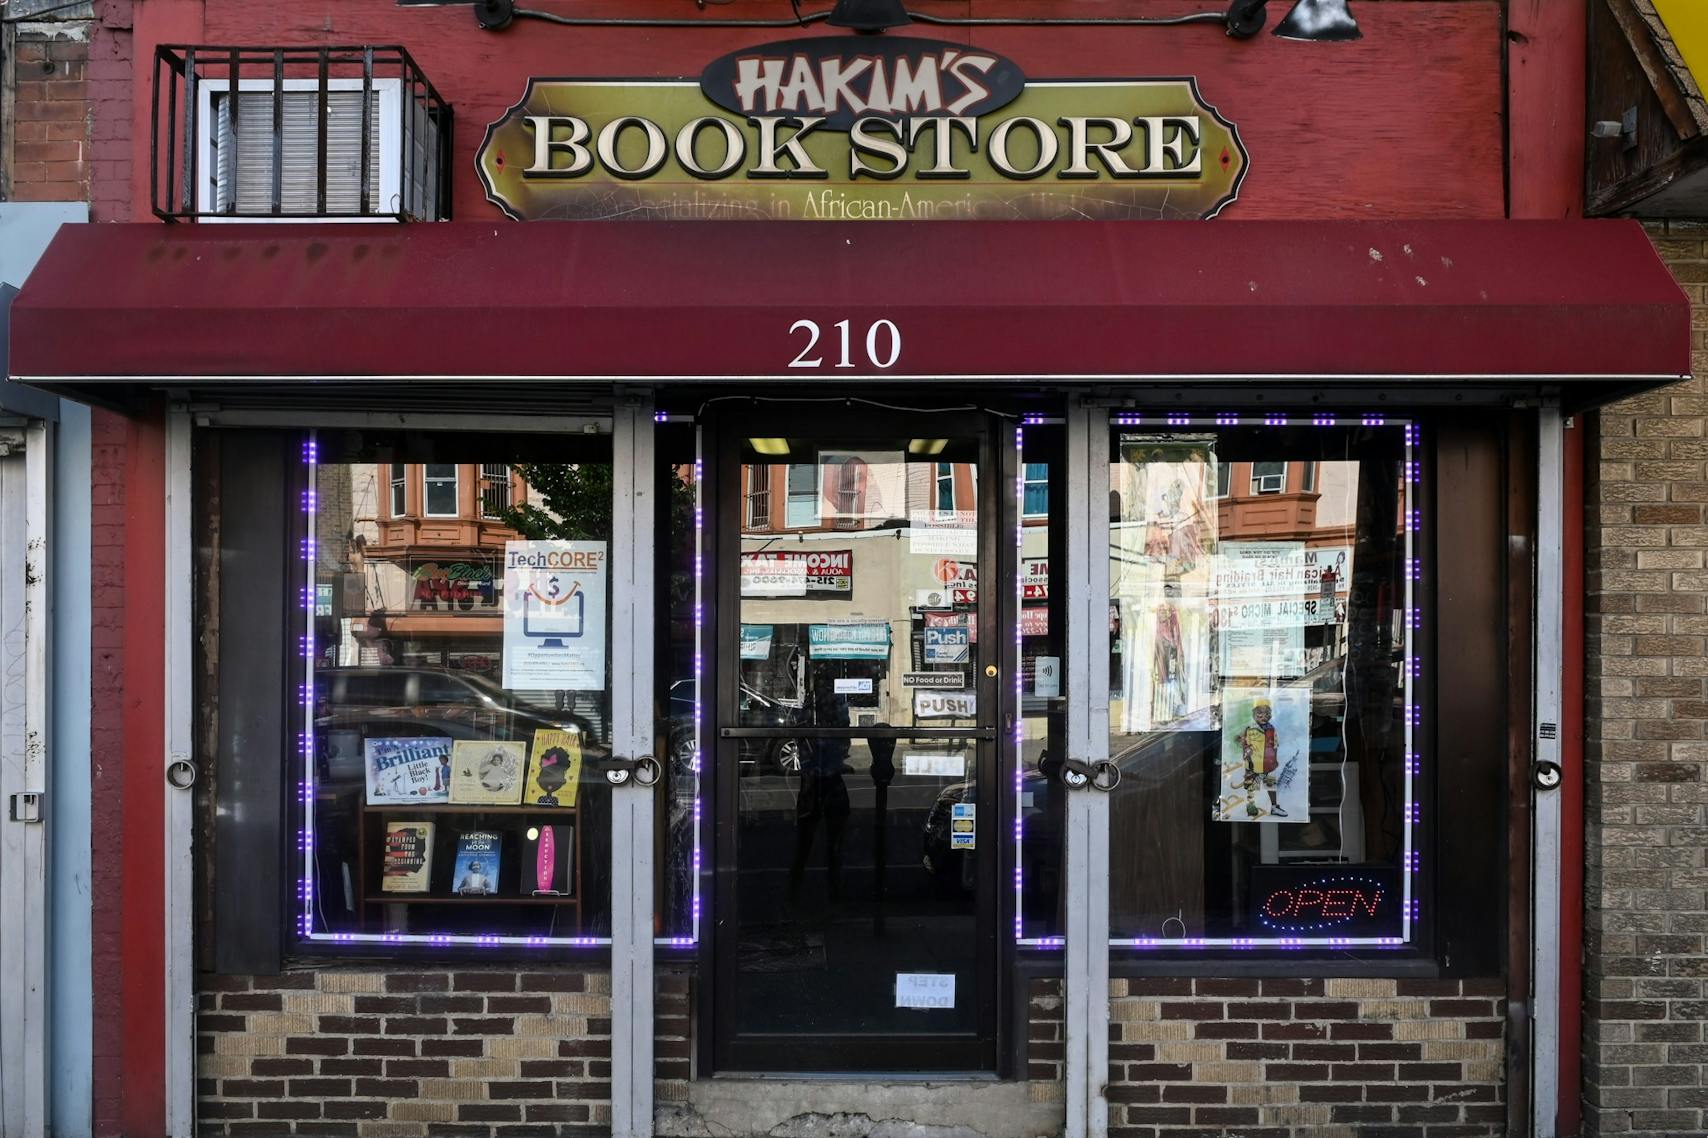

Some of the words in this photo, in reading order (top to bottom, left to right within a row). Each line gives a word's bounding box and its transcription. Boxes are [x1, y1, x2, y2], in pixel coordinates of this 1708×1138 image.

[732, 48, 1000, 116] HAKIM'S
[522, 115, 828, 179] BOOK
[848, 115, 1202, 179] STORE
[787, 318, 902, 369] 210
[926, 629, 968, 644] Push
[903, 675, 915, 683] NO
[916, 675, 933, 683] Food
[920, 698, 967, 713] PUSH
[377, 744, 449, 772] Brilliant
[408, 761, 429, 770] Little
[409, 768, 431, 778] Black
[1266, 890, 1381, 917] OPEN
